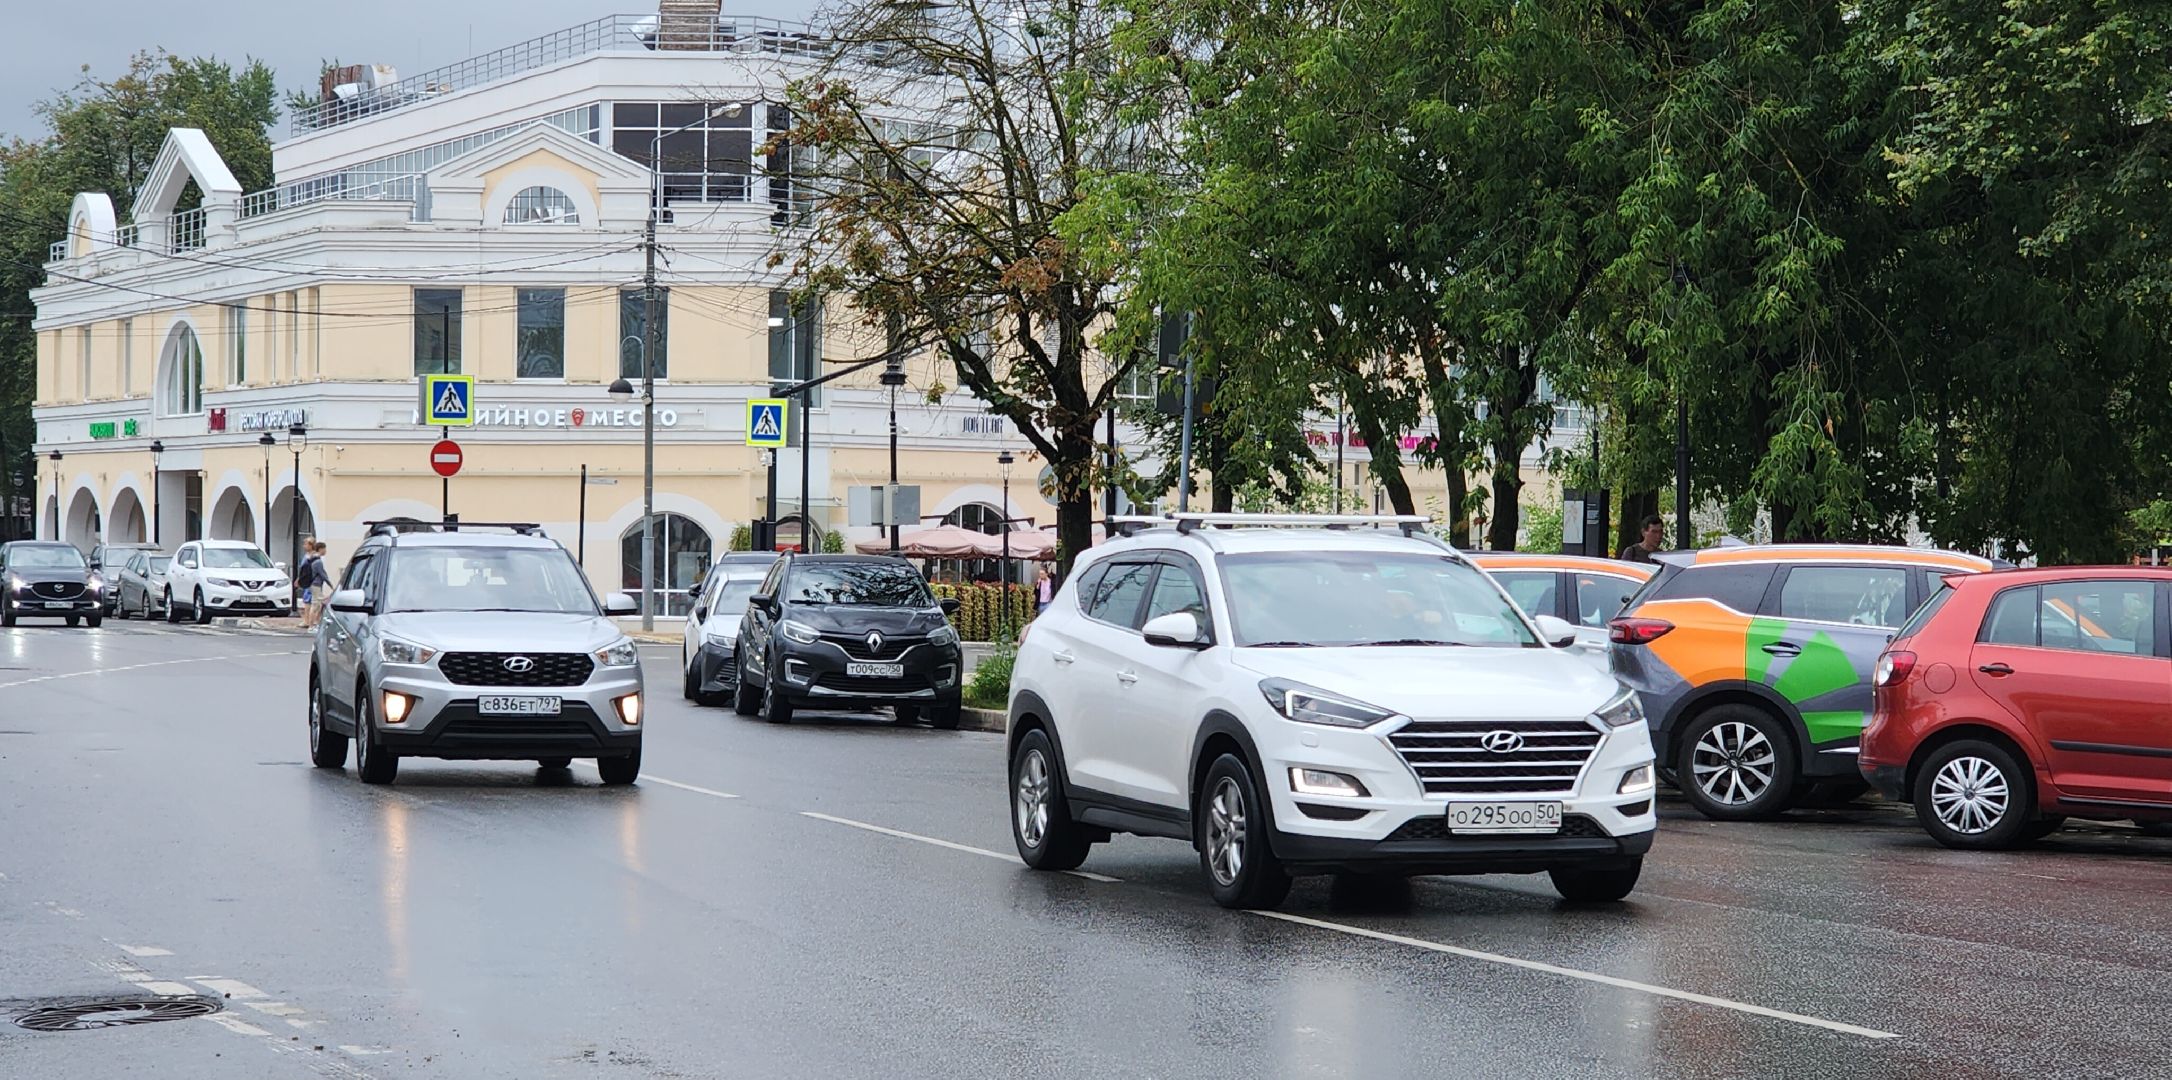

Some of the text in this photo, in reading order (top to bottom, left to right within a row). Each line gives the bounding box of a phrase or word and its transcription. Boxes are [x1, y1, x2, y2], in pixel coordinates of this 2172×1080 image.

[591, 408, 677, 427] МЕСО
[483, 697, 558, 711] С836ЕТ 797
[1456, 804, 1555, 825] О295ОО 50
